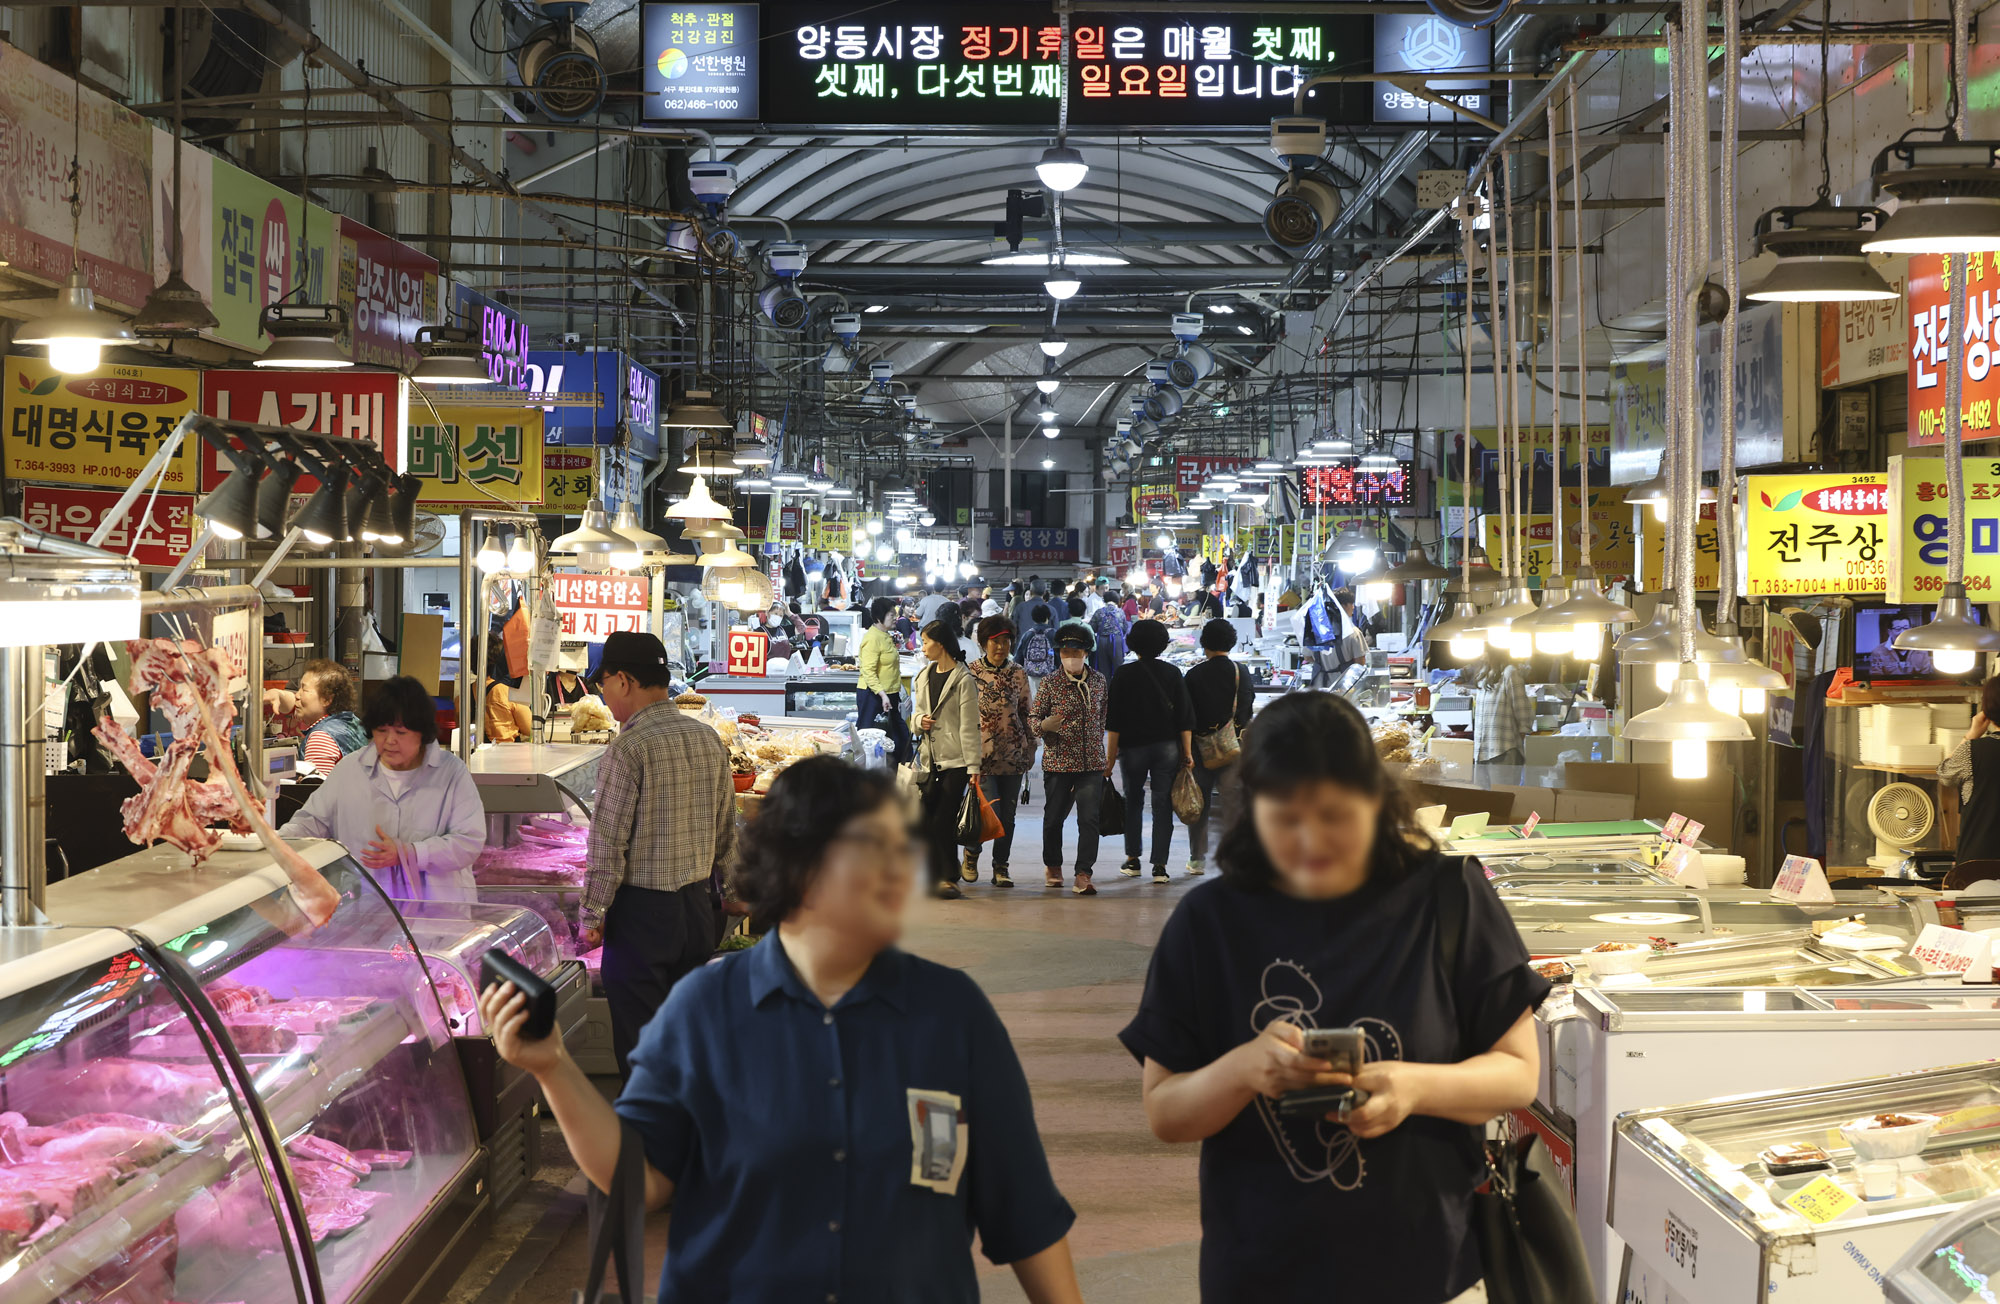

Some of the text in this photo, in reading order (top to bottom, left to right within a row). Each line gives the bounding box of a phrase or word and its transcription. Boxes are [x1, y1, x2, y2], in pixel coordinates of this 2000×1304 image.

[670, 30, 734, 45] 건강검진
[797, 26, 1336, 62] 양동시장 정기휴일은 매월 첫째,
[692, 55, 746, 72] 선한병원
[815, 64, 1316, 99] 셋째, 다섯번째 일요일입니다.
[664, 99, 738, 110] 062)466-1000
[221, 206, 255, 303] 잡곡
[265, 219, 286, 321] 쌀
[80, 257, 137, 299] 10-8607-9695
[113, 368, 143, 378] (404호)
[86, 381, 168, 403] 수입쇠고기
[1918, 398, 1992, 437] 010-3-4192
[12, 404, 185, 459] 대명식육점
[408, 424, 523, 485] 버섯
[14, 459, 76, 474] T.364-3993
[547, 474, 592, 498] 상회
[1851, 475, 1876, 484] 349호
[167, 505, 190, 557] 전문
[1002, 530, 1068, 547] 동영상회
[1847, 560, 1887, 575] 010-36
[1752, 579, 1827, 594] T.363-7004
[1913, 575, 1992, 592] 366-264
[561, 611, 641, 635] 돼지고기
[729, 635, 765, 675] 오리
